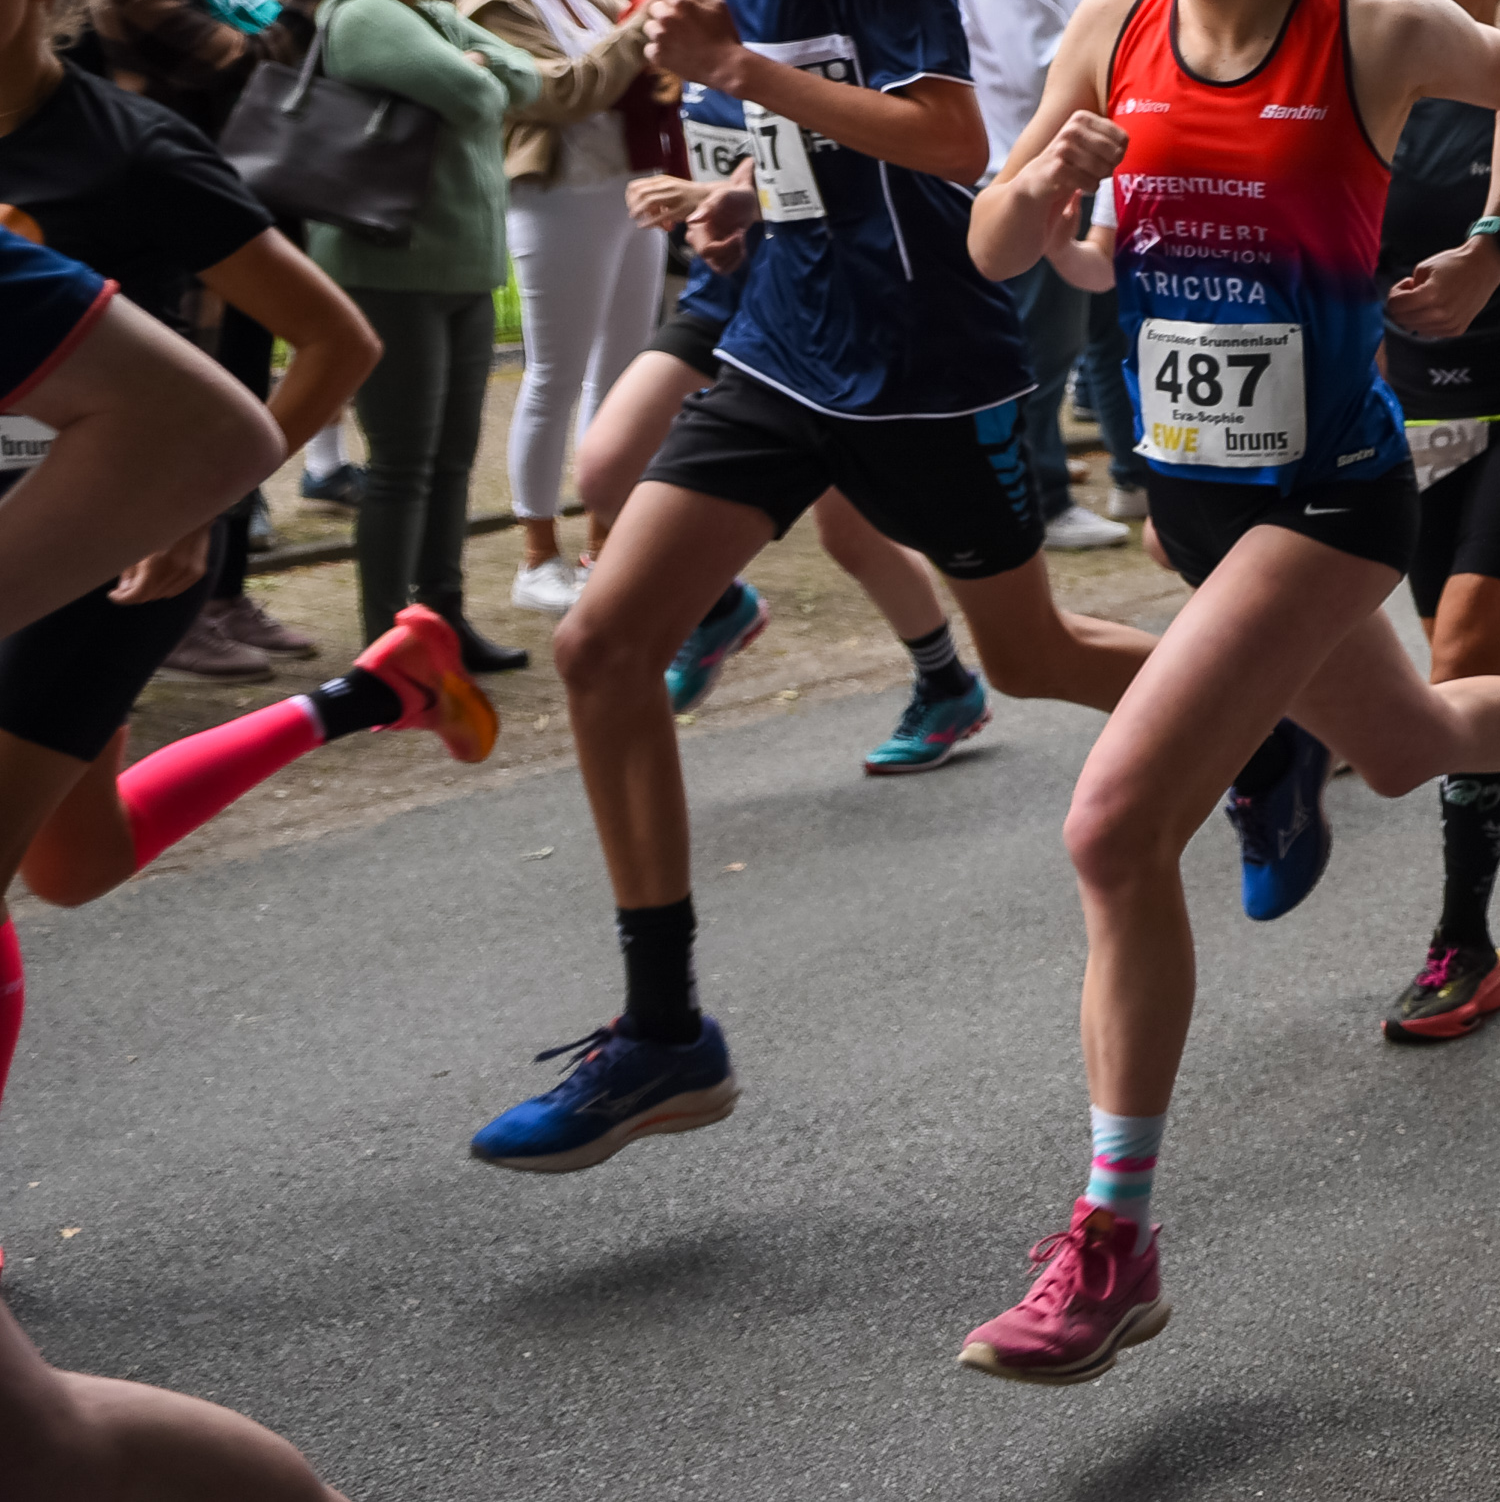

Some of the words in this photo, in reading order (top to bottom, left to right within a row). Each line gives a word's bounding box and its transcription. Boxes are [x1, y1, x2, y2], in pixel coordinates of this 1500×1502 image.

[1259, 103, 1329, 121] Santini
[1134, 173, 1266, 199] ÖFFENTLICHE
[1136, 270, 1267, 305] TRICURA
[1200, 334, 1289, 348] Brunnenlauf
[1155, 350, 1271, 408] 487
[1172, 409, 1245, 426] Eva-Sophie
[1, 434, 53, 456] brun
[1152, 422, 1199, 453] EWE
[1225, 427, 1289, 451] bruns
